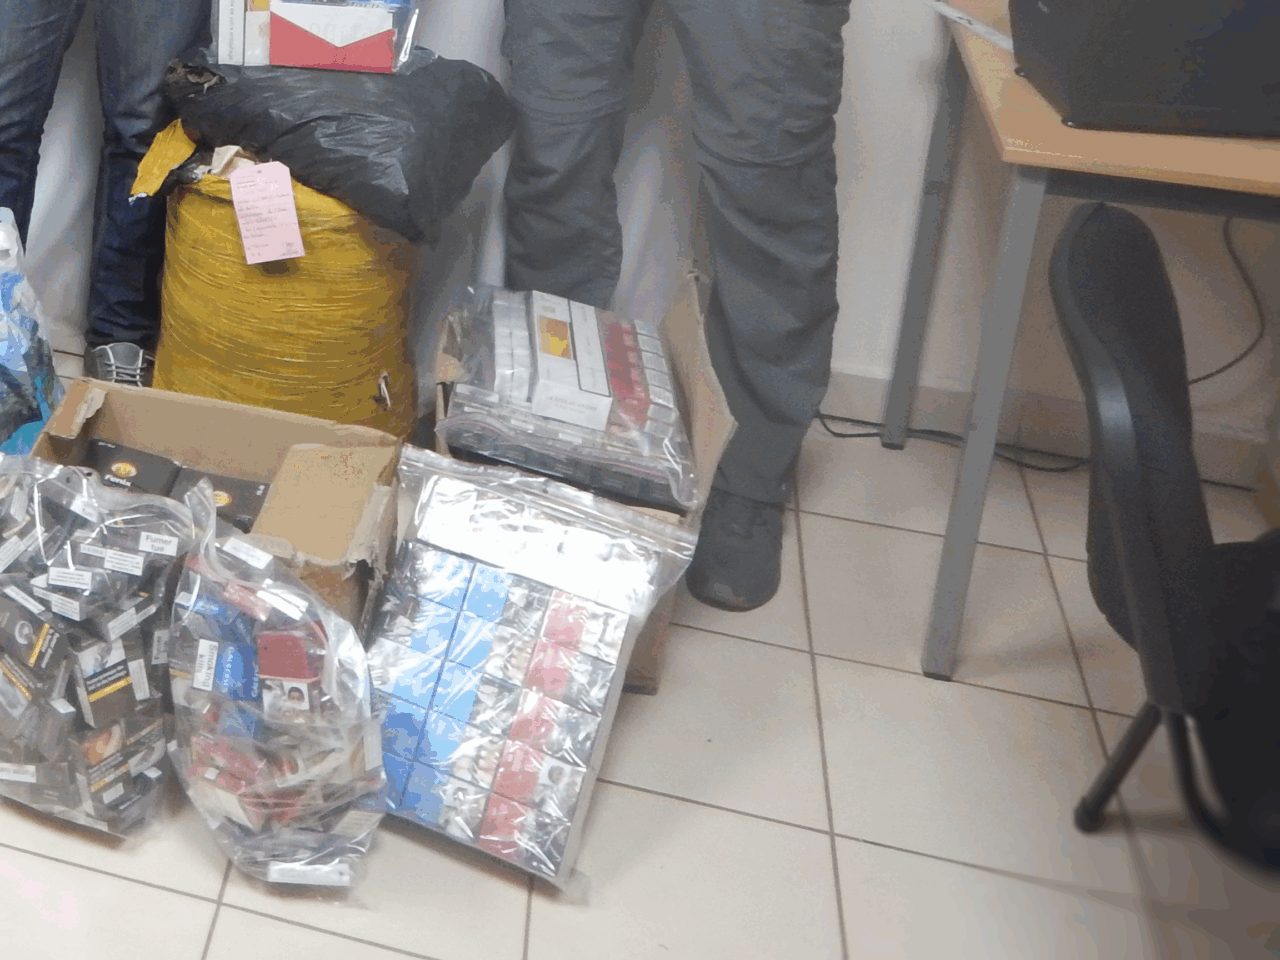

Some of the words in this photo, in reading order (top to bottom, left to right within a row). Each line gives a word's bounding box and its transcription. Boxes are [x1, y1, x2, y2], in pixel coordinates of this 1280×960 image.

[145, 535, 173, 546] Fumer
[151, 544, 165, 552] tue
[196, 653, 206, 674] kills
[202, 644, 217, 688] Smoking
